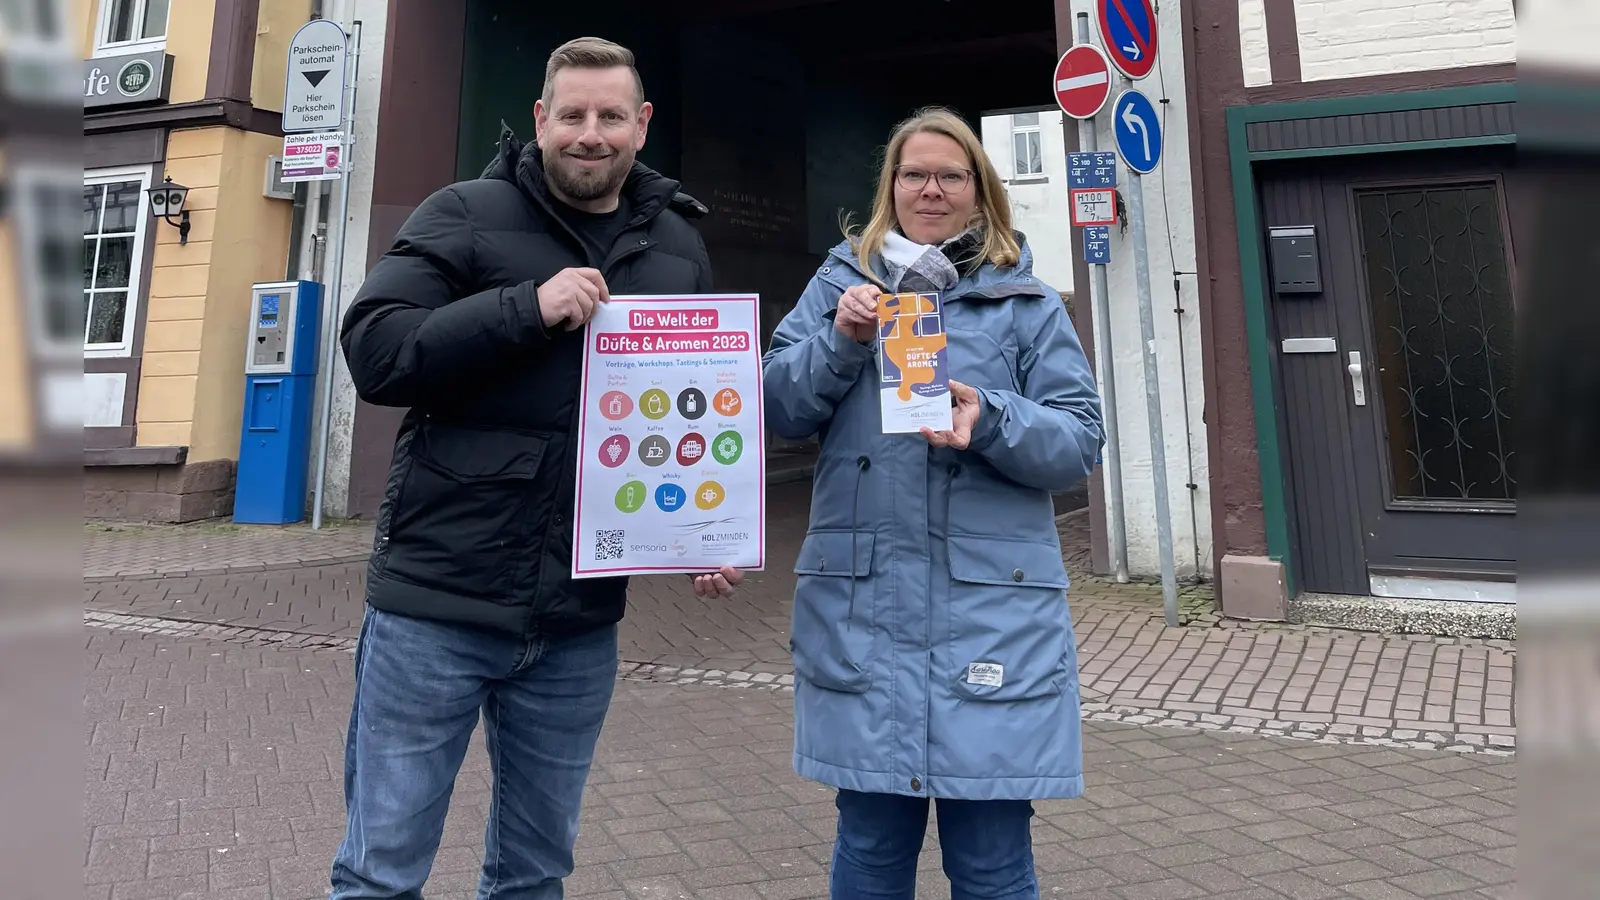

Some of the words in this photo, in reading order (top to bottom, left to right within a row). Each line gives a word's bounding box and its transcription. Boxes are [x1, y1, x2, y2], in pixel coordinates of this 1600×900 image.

[294, 44, 344, 54] Parkschein-
[300, 54, 334, 64] automat
[84, 68, 110, 96] fe
[126, 74, 145, 86] JEVER
[292, 103, 335, 112] Parkschein
[296, 145, 322, 154] 375022
[1072, 158, 1078, 166] S
[1097, 156, 1103, 165] S
[1090, 231, 1096, 239] S
[633, 312, 654, 327] Die
[657, 312, 688, 326] Welt
[692, 312, 714, 326] der
[600, 336, 639, 351] Düfte
[642, 336, 653, 350] &
[656, 338, 709, 350] Aromen
[712, 335, 746, 349] 2023
[906, 352, 931, 360] DÜFTE
[605, 360, 636, 369] Vorträge,
[908, 360, 938, 368] AROMEN
[702, 532, 748, 542] HOLZMINDEN
[630, 543, 667, 552] sensoria
